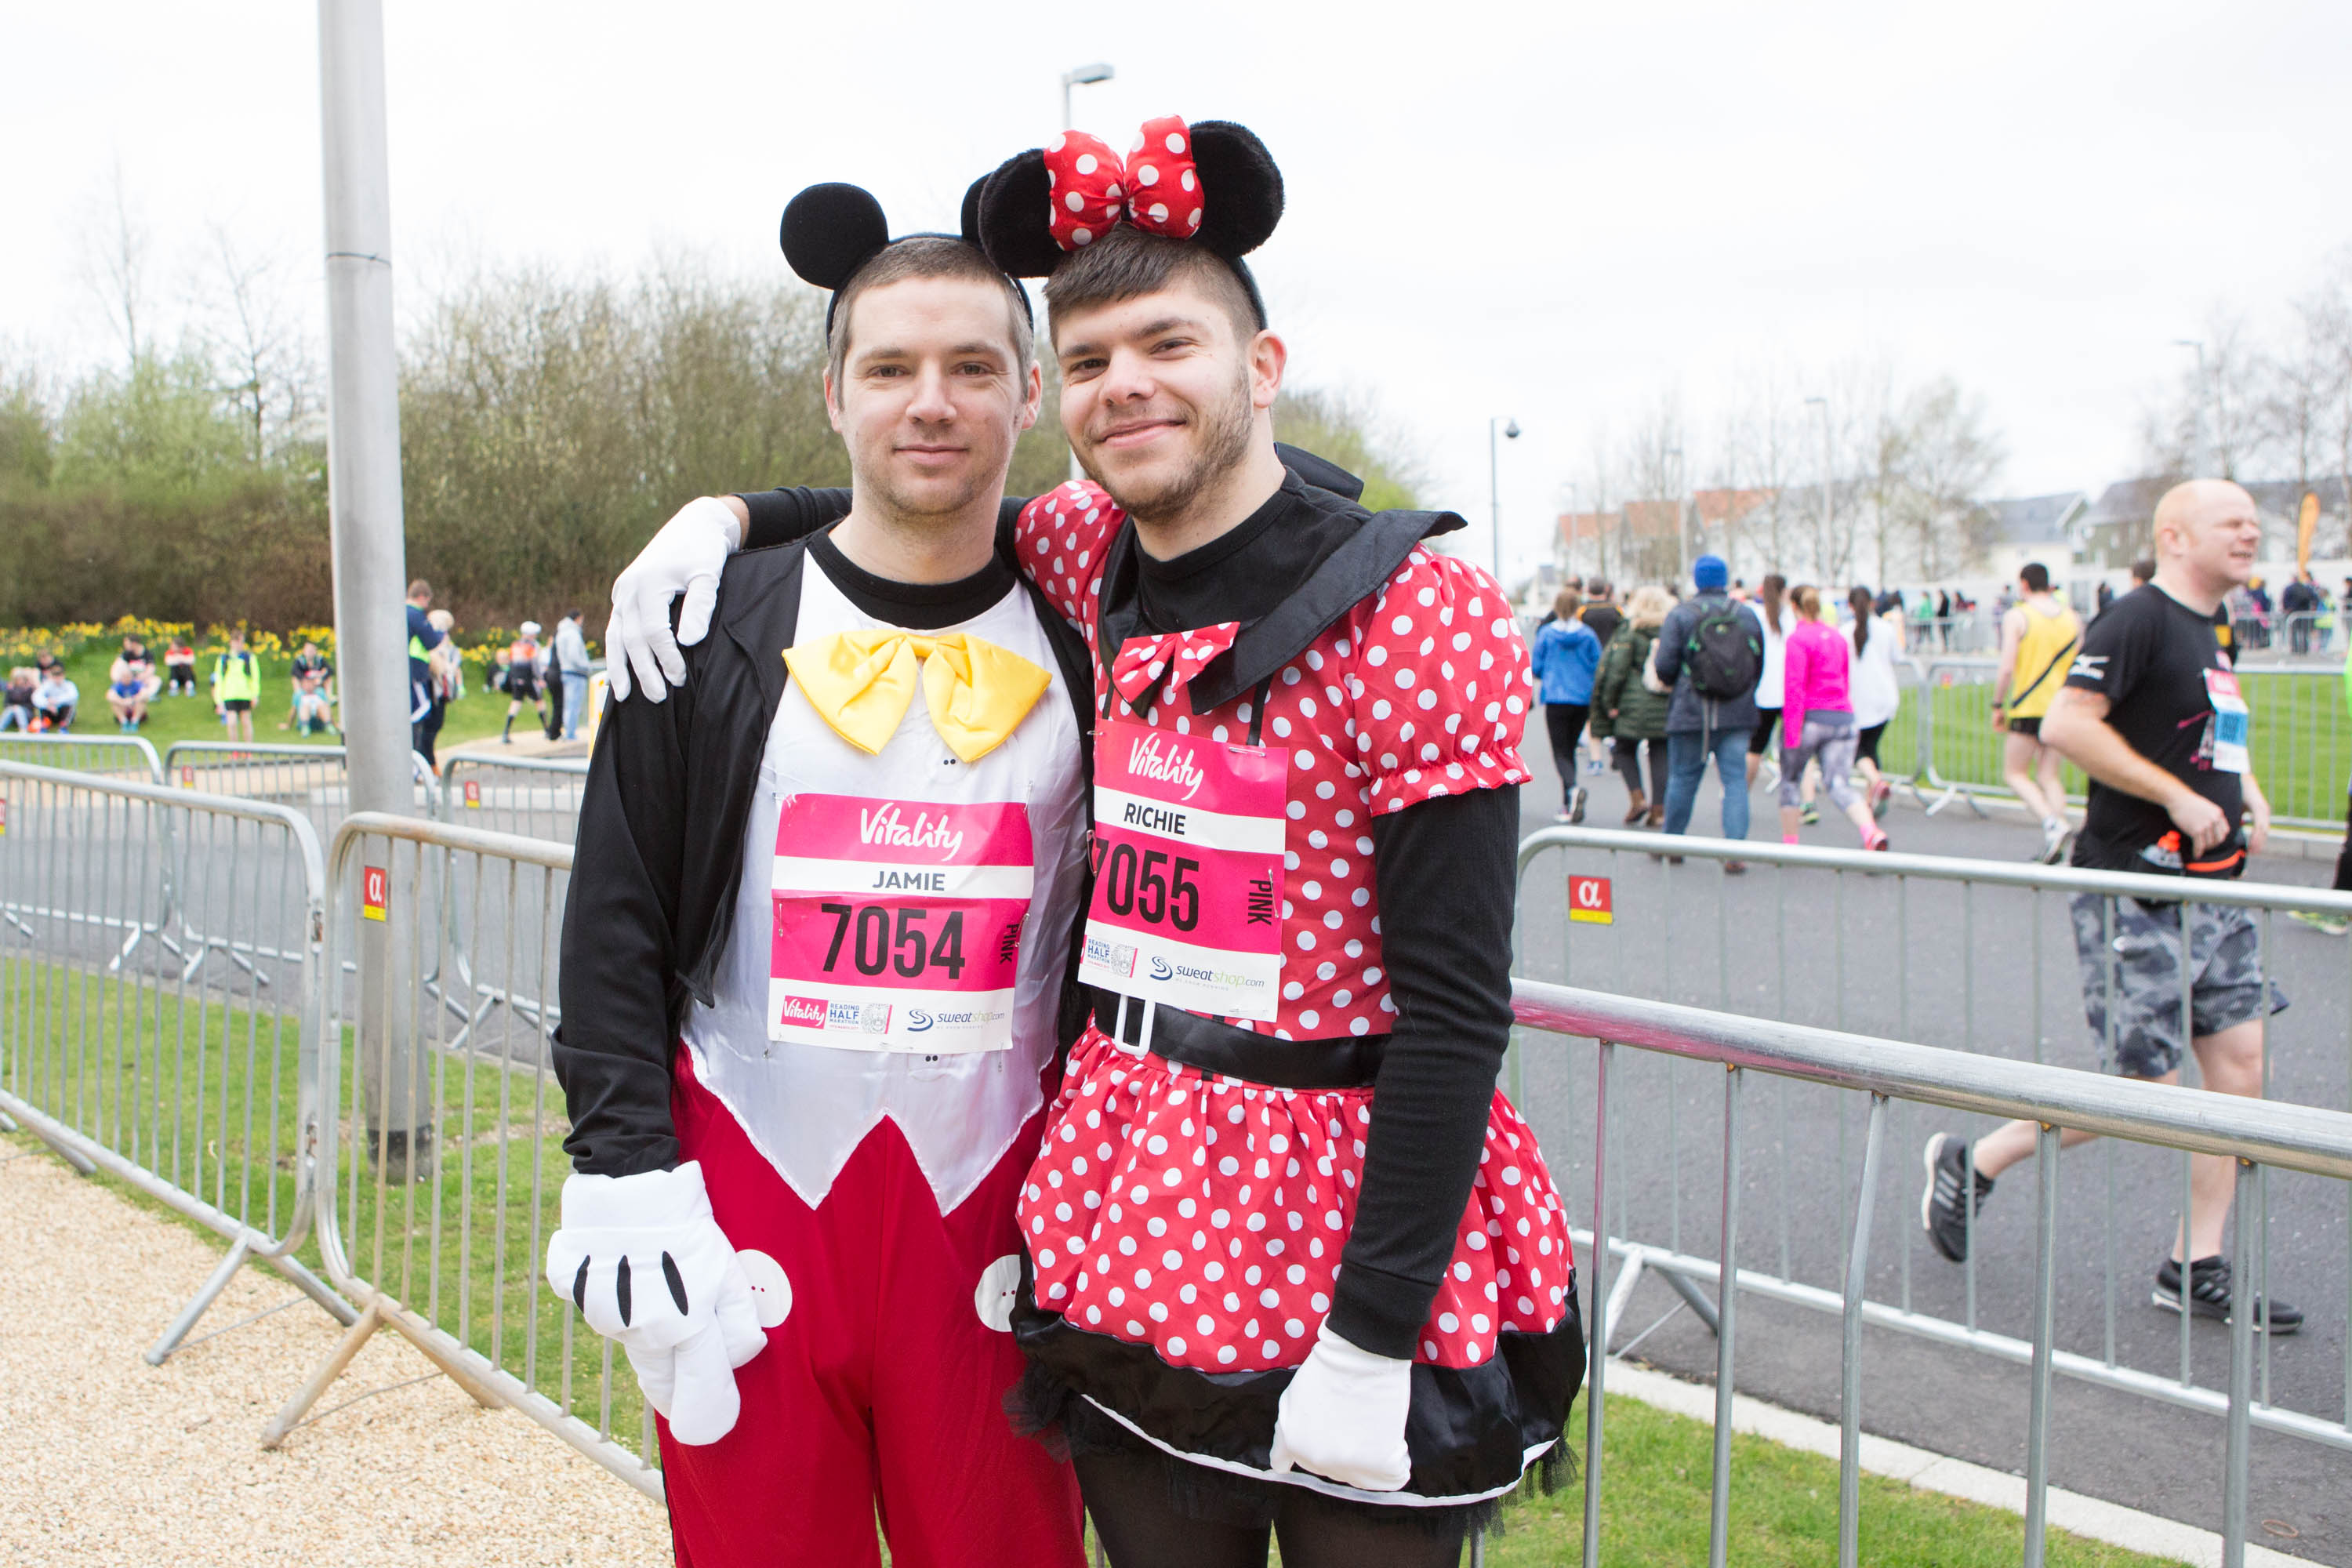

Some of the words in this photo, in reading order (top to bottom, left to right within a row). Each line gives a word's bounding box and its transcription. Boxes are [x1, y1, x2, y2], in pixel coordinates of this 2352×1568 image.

[1128, 732, 1203, 800] Vitality
[861, 802, 964, 861] Vitality
[1123, 802, 1186, 835] RICHIE
[872, 871, 946, 891] JAMIE
[1247, 879, 1274, 926] PINK
[821, 903, 965, 980] 7054
[1000, 924, 1020, 964] PINK
[1087, 945, 1110, 958] HALF
[1176, 965, 1265, 988] sweatshop.com
[784, 998, 825, 1026] Vitality
[829, 1010, 859, 1020] HALF
